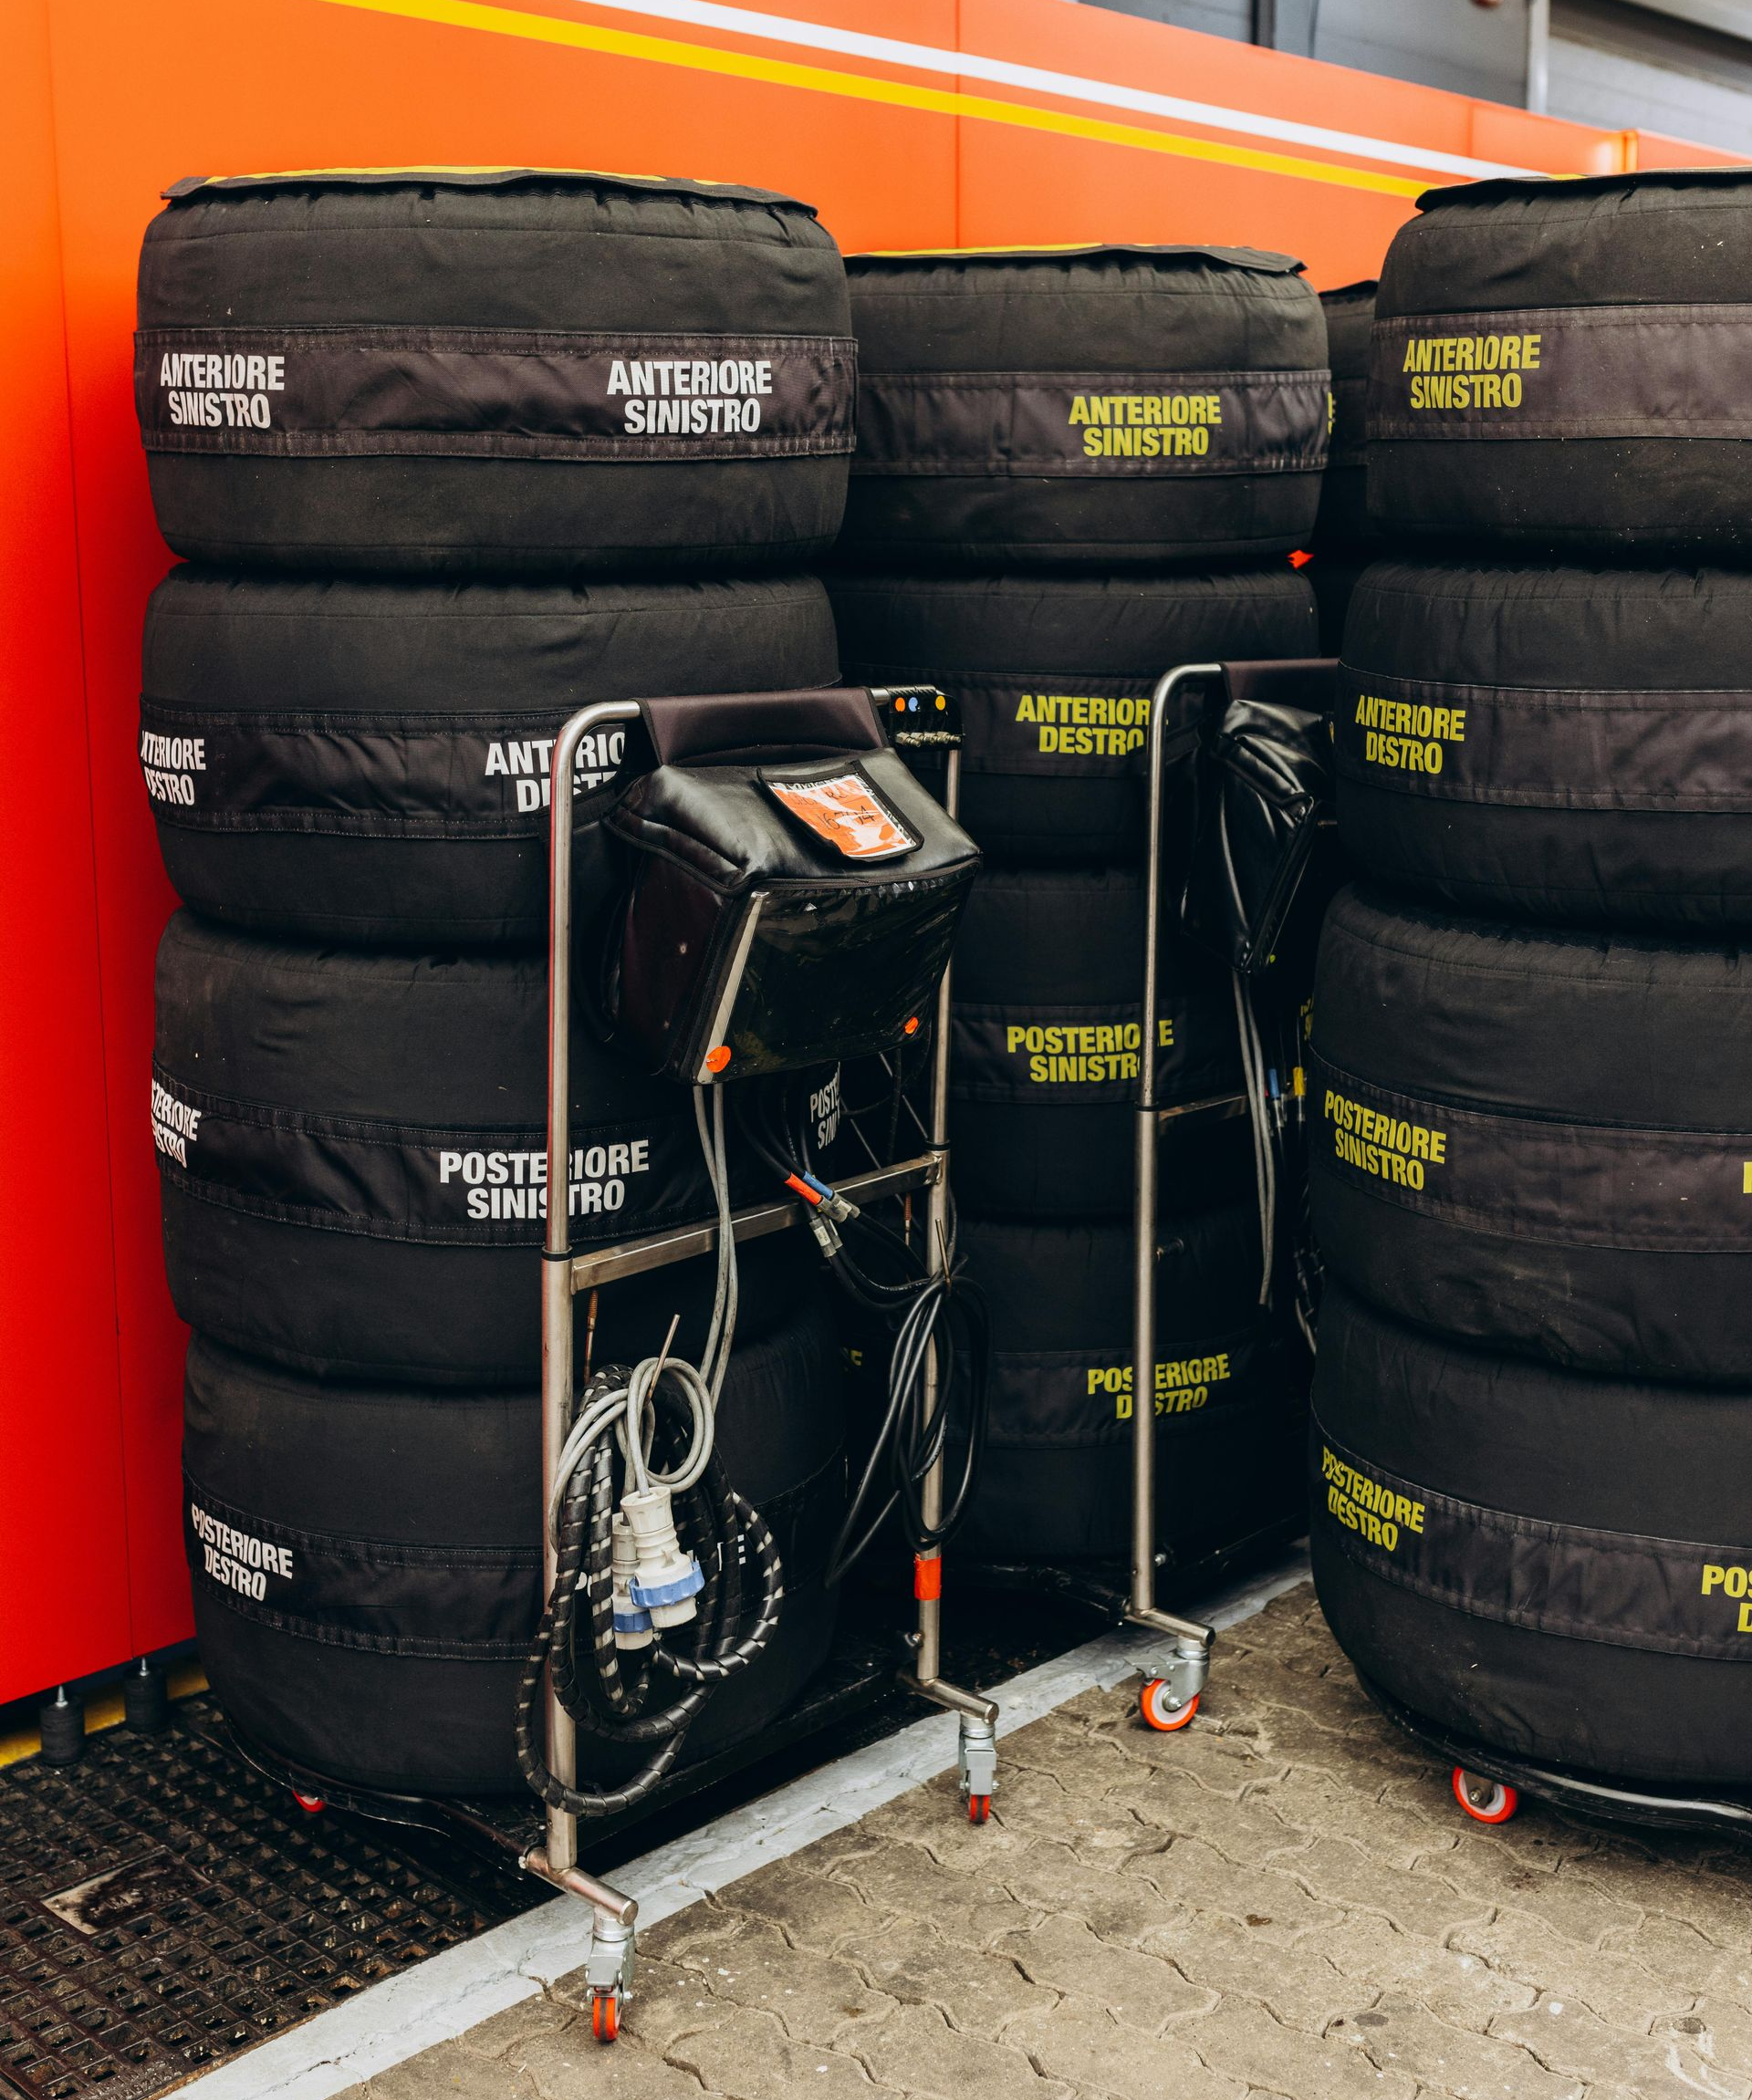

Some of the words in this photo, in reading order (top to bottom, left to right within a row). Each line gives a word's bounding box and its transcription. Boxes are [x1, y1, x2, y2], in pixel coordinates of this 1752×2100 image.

[160, 352, 287, 391] ANTERIORE
[1403, 334, 1543, 373] ANTERIORE
[606, 359, 774, 396] ANTERIORE
[1409, 373, 1523, 410] SINISTRO
[168, 390, 271, 429] SINISTRO
[624, 396, 761, 435] SINISTRO
[1069, 394, 1223, 426] ANTERIORE
[1082, 426, 1210, 458] SINISTRO
[1016, 694, 1150, 726] ANTERIOR
[1355, 694, 1467, 743] ANTERIORE
[1364, 730, 1444, 775] DESTRO
[1006, 1019, 1174, 1055] POSTERIOE
[1029, 1052, 1141, 1083] SINISTR
[1324, 1089, 1447, 1164] POSTERIORE
[440, 1139, 650, 1185] POSTEIORE
[1334, 1127, 1424, 1190] SINISTRO
[1087, 1353, 1231, 1395] POSERIORE
[1116, 1385, 1208, 1419] DSTRO
[1321, 1445, 1425, 1534] POSTERIORE
[1328, 1484, 1399, 1552] DESTRO
[191, 1502, 293, 1580] POSTERIORE
[203, 1543, 267, 1602] DESTRO
